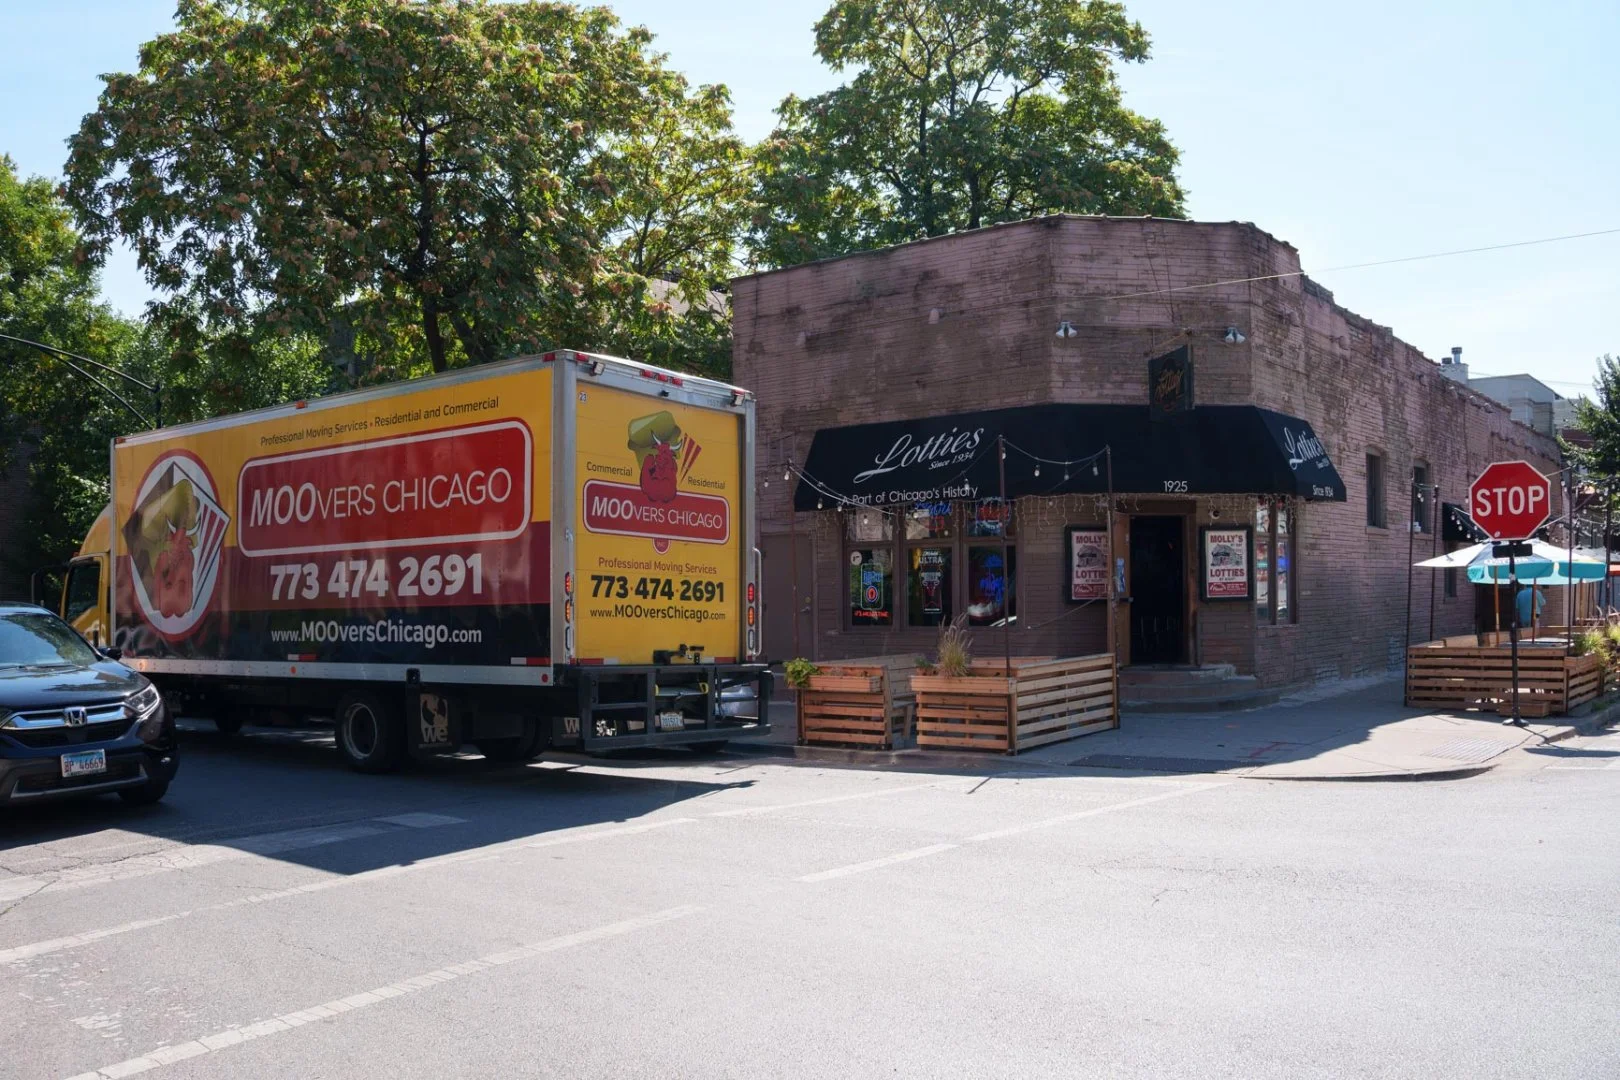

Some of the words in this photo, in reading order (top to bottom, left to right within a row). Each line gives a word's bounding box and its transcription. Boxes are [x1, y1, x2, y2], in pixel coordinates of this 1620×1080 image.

[260, 431, 304, 447] Professional
[306, 426, 333, 439] Moving
[335, 421, 368, 435] Services
[374, 413, 422, 428] Residential
[424, 408, 441, 420] and
[443, 396, 499, 417] Commercial
[853, 427, 985, 484] Lotties
[586, 461, 633, 477] Commercial
[687, 475, 726, 490] Residential
[1163, 480, 1188, 493] 1925
[249, 482, 376, 528] MOOVERS
[383, 468, 512, 513] CHICAGO
[852, 493, 872, 504] Part
[875, 491, 886, 503] of
[889, 487, 940, 502] Chicago's
[943, 484, 978, 499] History
[1475, 485, 1545, 517] STOP
[591, 496, 665, 523] MOOVERS
[667, 509, 723, 530] CHICAGO
[1210, 534, 1244, 543] MOLLY'S
[598, 556, 652, 570] Professional
[653, 560, 683, 574] Moving
[685, 562, 717, 575] Services
[1210, 568, 1245, 578] LOTTIES
[270, 563, 320, 601] 773
[327, 558, 389, 599] 474
[398, 553, 483, 597] 2691
[589, 604, 726, 623] www.MOOversChicago.com
[271, 619, 482, 649] www.MOOversChicago.com
